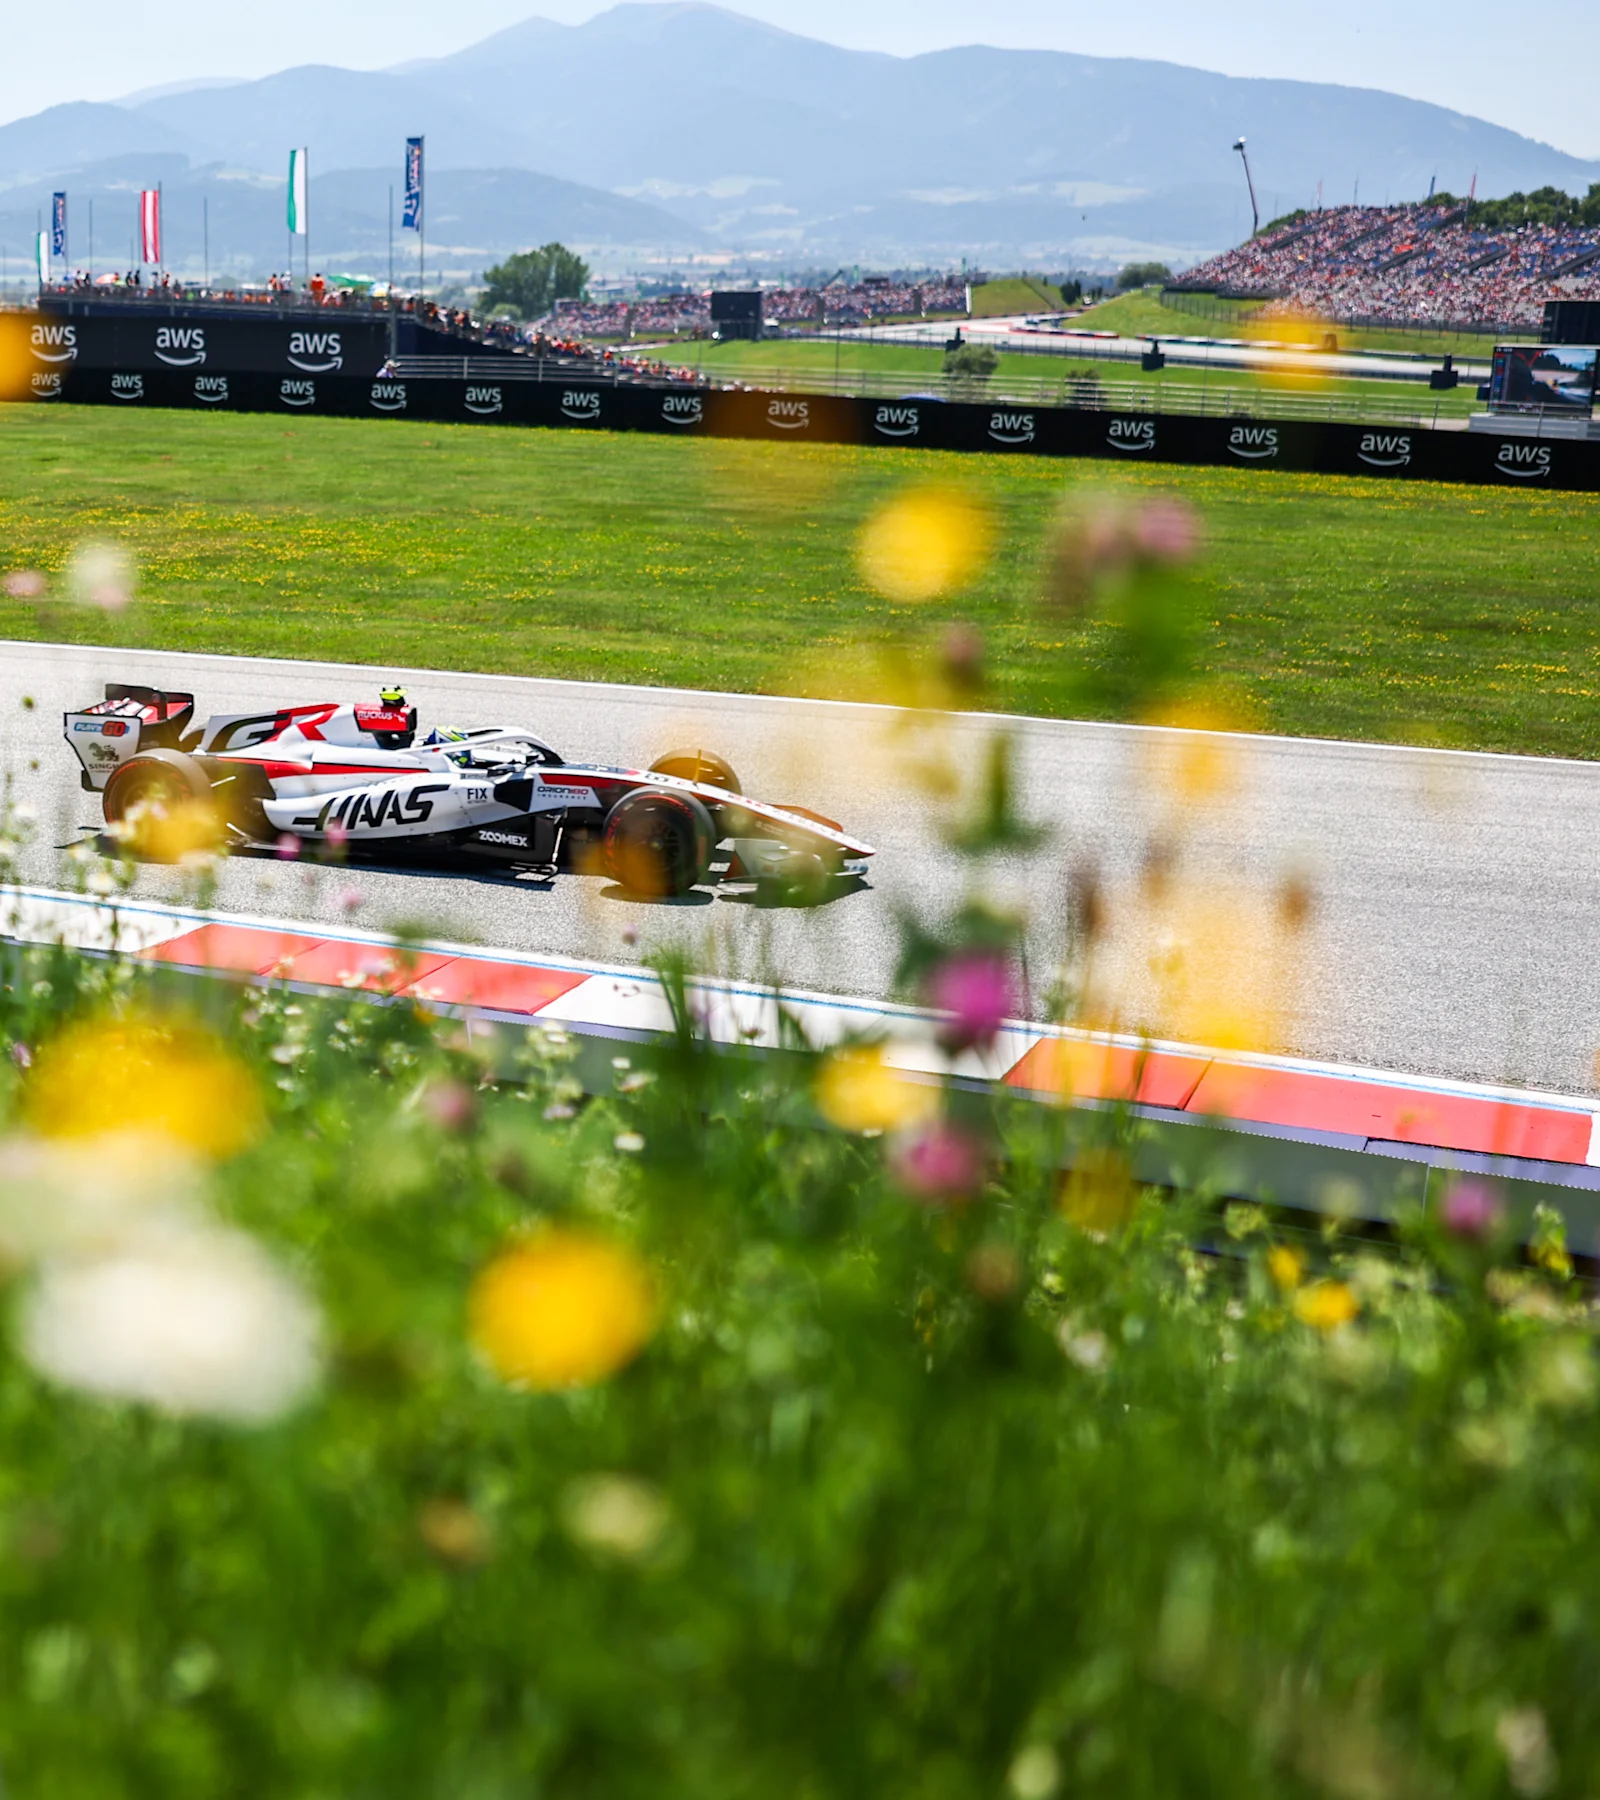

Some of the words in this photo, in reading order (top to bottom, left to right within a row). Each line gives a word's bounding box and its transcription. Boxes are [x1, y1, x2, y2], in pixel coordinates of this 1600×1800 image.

[31, 325, 76, 345] aws
[156, 328, 204, 349] aws
[290, 333, 341, 355] aws
[32, 373, 62, 387] aws
[111, 374, 142, 389] aws
[195, 376, 227, 391] aws
[281, 380, 315, 395] aws
[371, 383, 406, 399] aws
[465, 387, 501, 403] aws
[562, 391, 600, 408] aws
[663, 396, 701, 413] aws
[768, 401, 809, 417] aws
[876, 406, 918, 424] aws
[990, 413, 1034, 431] aws
[1109, 420, 1155, 438] aws
[1230, 427, 1278, 445] aws
[1361, 434, 1411, 454] aws
[1498, 444, 1551, 464] aws
[103, 721, 125, 736] GO
[467, 788, 488, 800] FIX
[292, 784, 451, 831] HAAS
[478, 829, 529, 848] ZOOMEX
